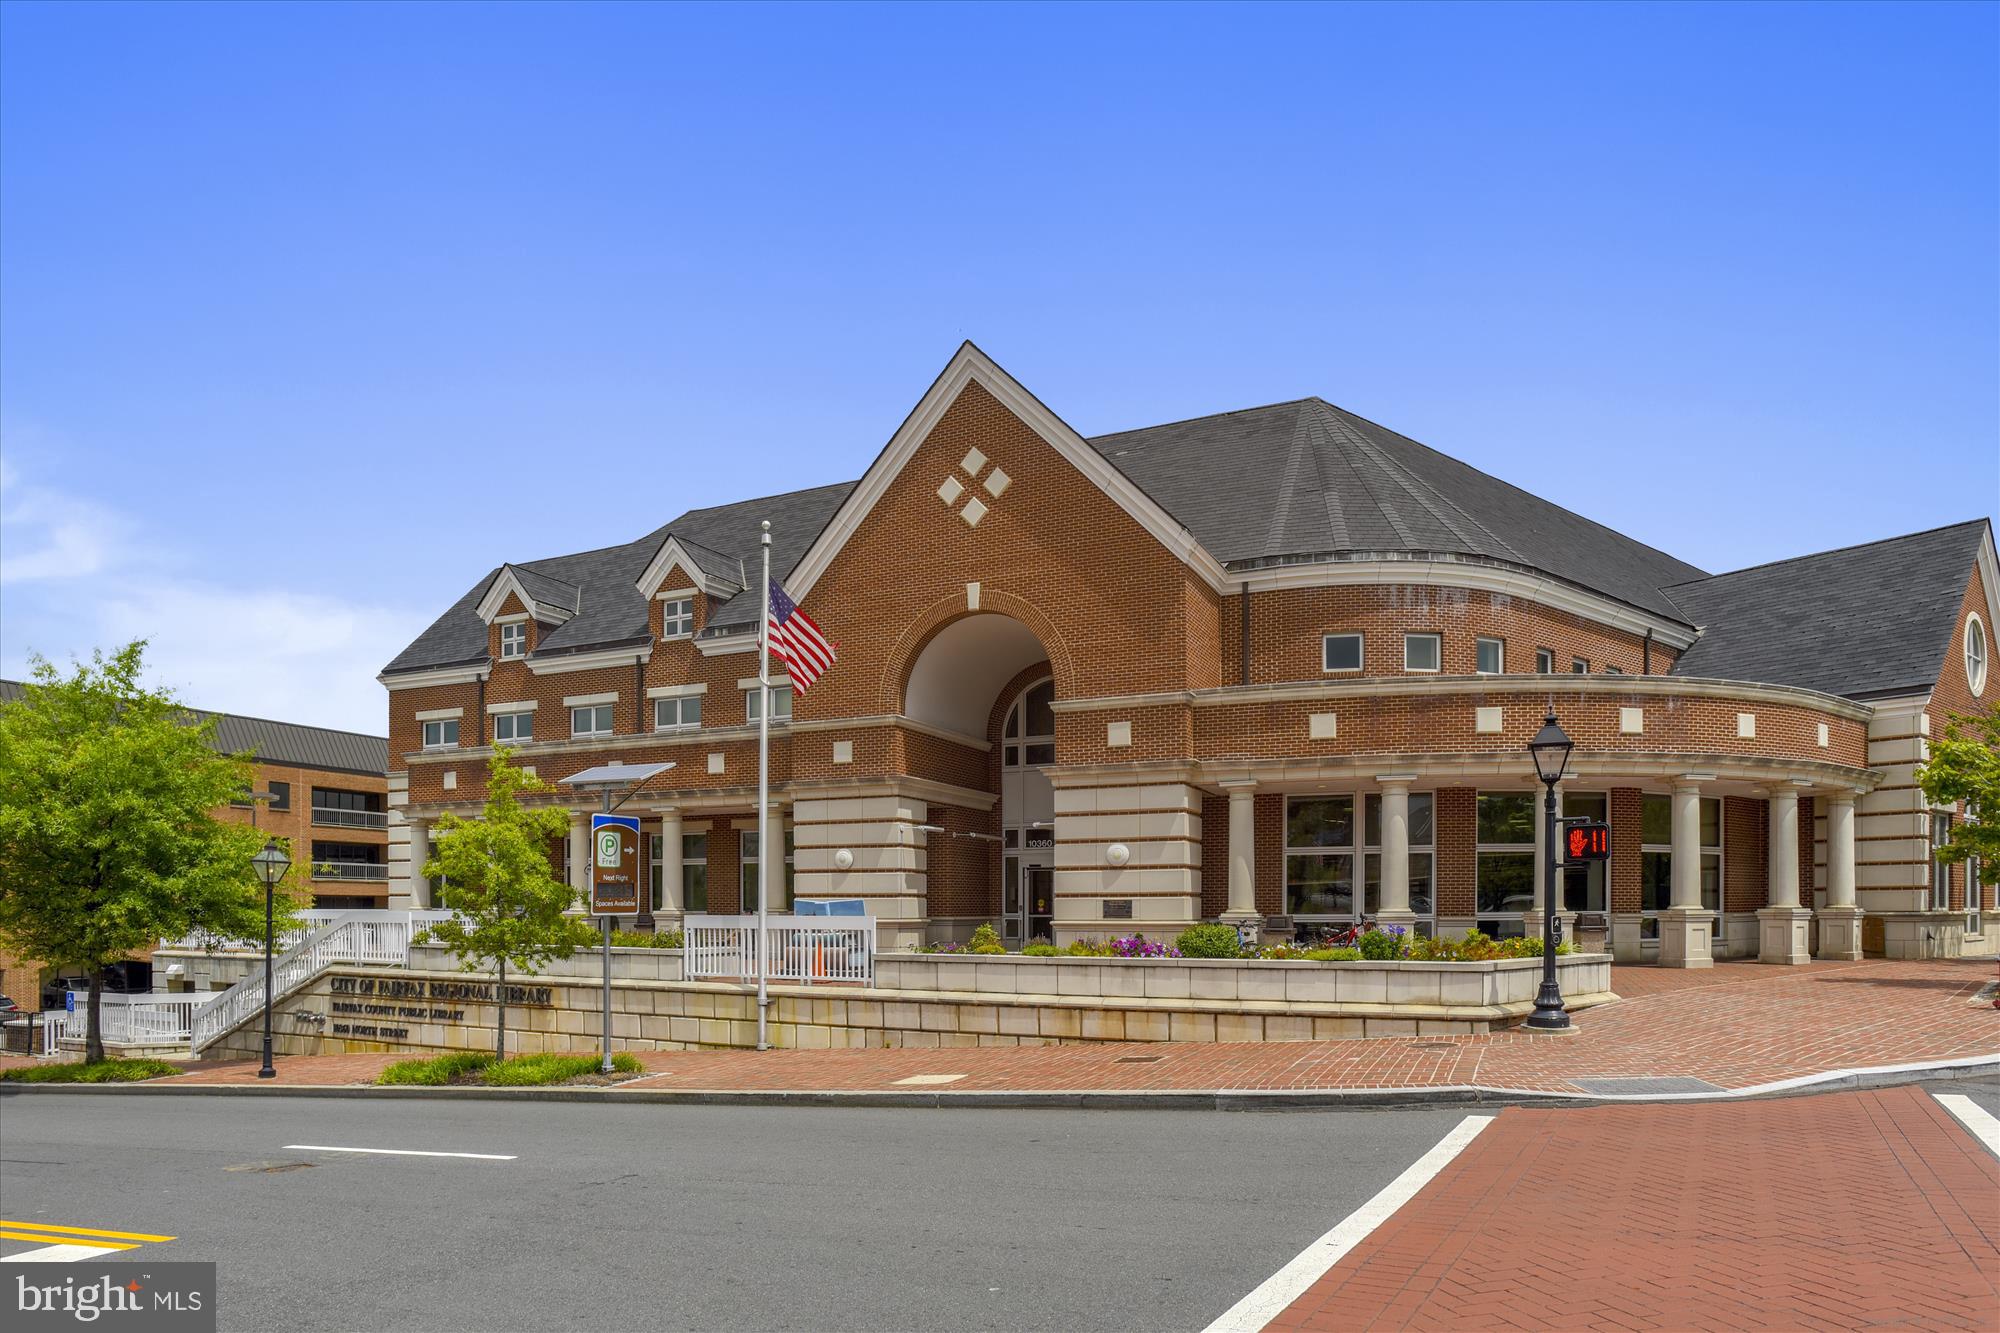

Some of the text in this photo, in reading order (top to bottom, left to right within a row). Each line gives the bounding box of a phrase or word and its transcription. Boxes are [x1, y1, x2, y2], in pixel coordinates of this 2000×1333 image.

[1029, 840, 1052, 848] 10360
[1592, 830, 1606, 853] 11
[602, 858, 617, 866] Free
[616, 874, 629, 882] Right
[596, 900, 614, 908] Spaces
[331, 978, 356, 992] CITY
[359, 980, 374, 993] OF
[379, 981, 425, 997] FAIRFAX
[430, 984, 493, 1000] REGIONAL
[333, 1003, 463, 1020] FAIRFAX COUNTY PUBLIC LIBRARY
[380, 1027, 408, 1039] STREET
